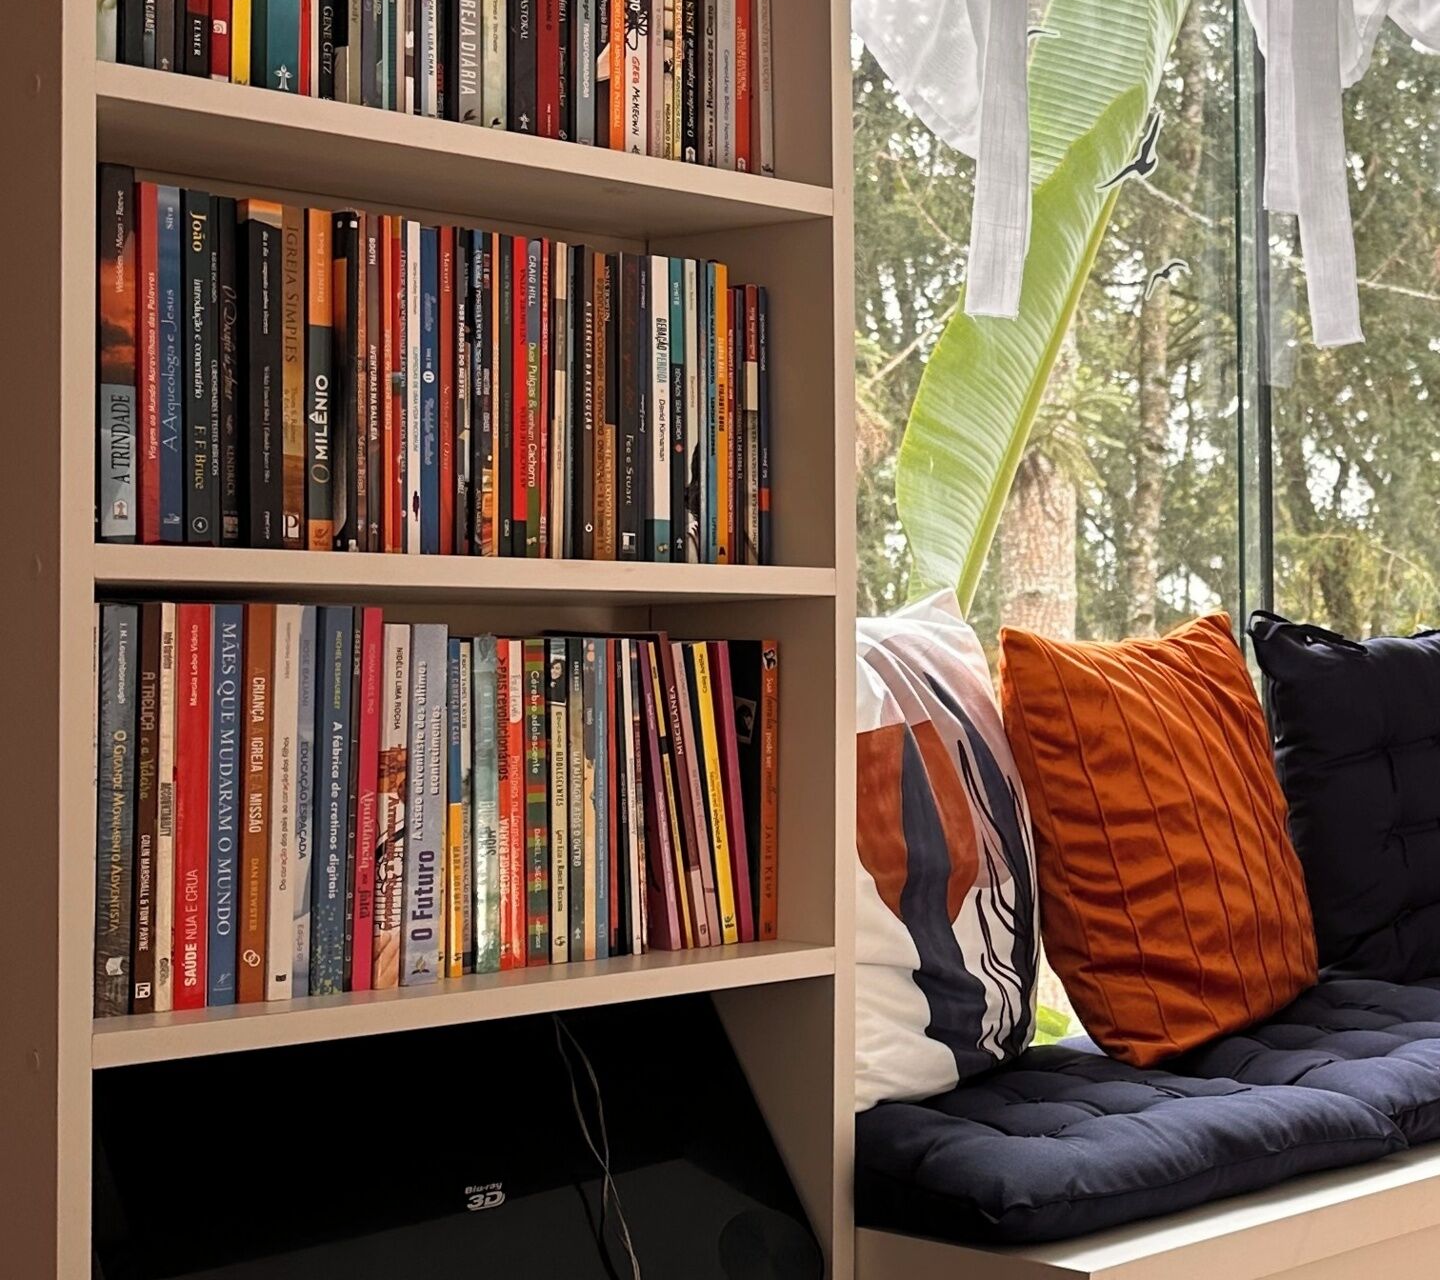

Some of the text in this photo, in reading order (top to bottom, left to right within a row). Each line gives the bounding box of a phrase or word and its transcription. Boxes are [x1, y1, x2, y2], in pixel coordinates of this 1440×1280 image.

[193, 20, 201, 56] ELMER
[322, 5, 333, 74] GENE GETZ
[461, 41, 478, 95] DIÁRIA
[189, 212, 206, 252] João
[284, 226, 299, 363] IGREJA SIMPLES
[528, 255, 536, 306] CRAIG HILL
[147, 272, 157, 459] Viagem ao Mundo Maravilhoso das Palavras
[161, 289, 180, 452] A Arqueologia e Jesus
[656, 318, 668, 383] GERAÇÃO PERDIDA
[111, 394, 130, 484] A TRINDADE
[194, 425, 206, 489] F. F. Bruce
[309, 375, 330, 483] O MILÊNIO
[226, 444, 235, 496] KENDRICK
[190, 654, 198, 675] Lobo
[190, 677, 198, 706] Marcia
[250, 677, 265, 723] CRIANÇA
[530, 670, 540, 774] Cérebro adolescente
[217, 622, 239, 936] MÃES QUE MUDARAM O MUNDO
[250, 736, 264, 772] IGREJA
[109, 729, 126, 931] O GRANDE MOVIMENTO ADVENTISTA
[249, 793, 263, 833] MISSÃO
[298, 741, 309, 859] EDUCAÇÃO ESPAÇADA
[328, 722, 343, 899] A fábrica de cretinos digitais
[183, 869, 198, 987] SAÚDE NUA E CRUA
[412, 850, 435, 941] O Futuro
[465, 1182, 502, 1194] Blu-ray
[467, 1191, 505, 1211] 3D
